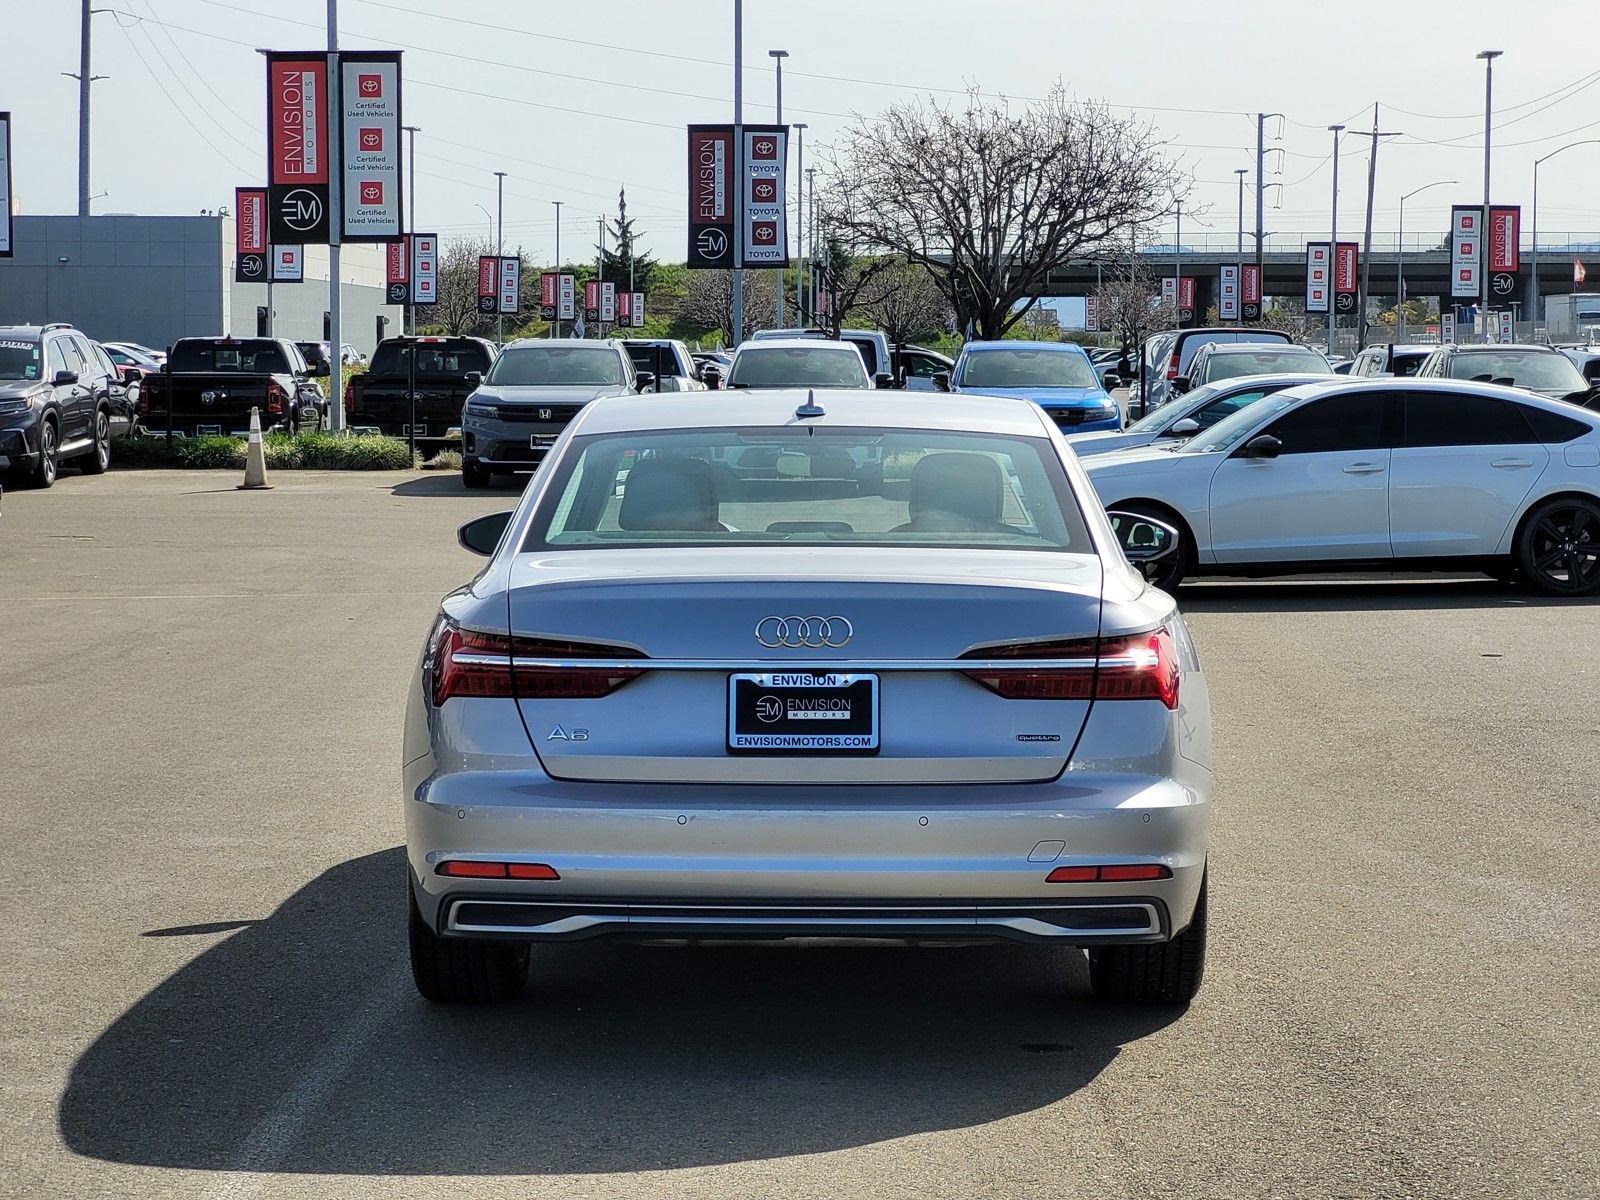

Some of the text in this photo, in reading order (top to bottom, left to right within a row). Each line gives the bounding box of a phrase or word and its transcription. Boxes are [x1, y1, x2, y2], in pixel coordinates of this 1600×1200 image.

[282, 71, 302, 174] ENVISION
[305, 80, 315, 169] MOTORS
[700, 139, 714, 217] ENVISION
[243, 196, 253, 249] ENVISION
[1494, 215, 1505, 267] ENVISION
[1338, 249, 1347, 289] ENVISION
[772, 675, 836, 686] ENVISION
[787, 699, 851, 710] ENVISION
[546, 723, 590, 741] A6
[736, 737, 871, 746] ENVISIONMOTORS.COM
